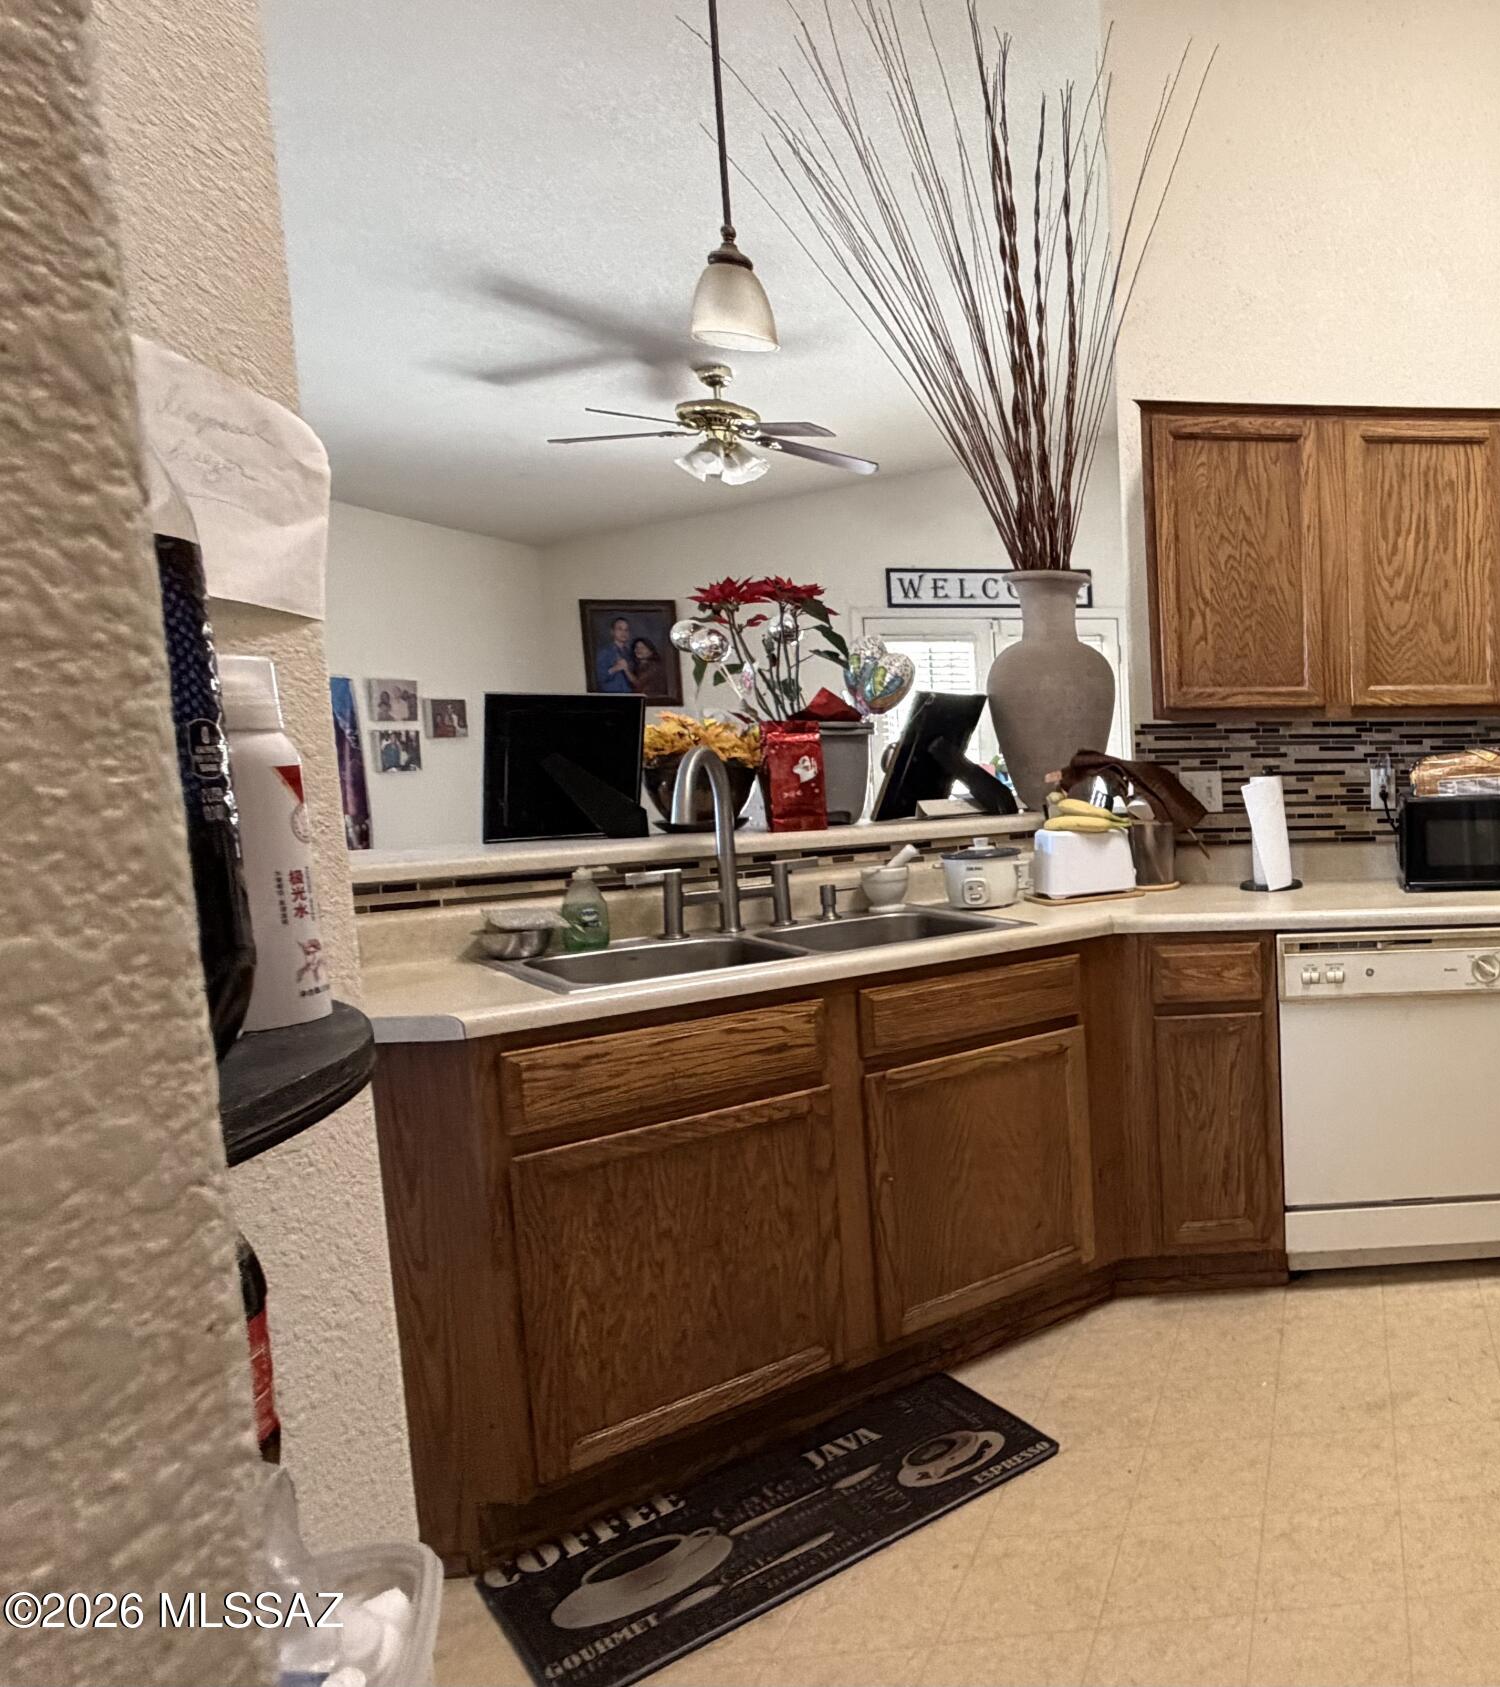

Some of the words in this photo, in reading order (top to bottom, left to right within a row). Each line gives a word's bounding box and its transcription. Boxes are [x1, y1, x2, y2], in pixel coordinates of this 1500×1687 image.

[896, 574, 1086, 600] WELC
[801, 1426, 884, 1471] JAVA
[970, 1440, 1051, 1484] ESPRESSO
[482, 1493, 687, 1589] COFFEE
[543, 1612, 660, 1680] GOURMET
